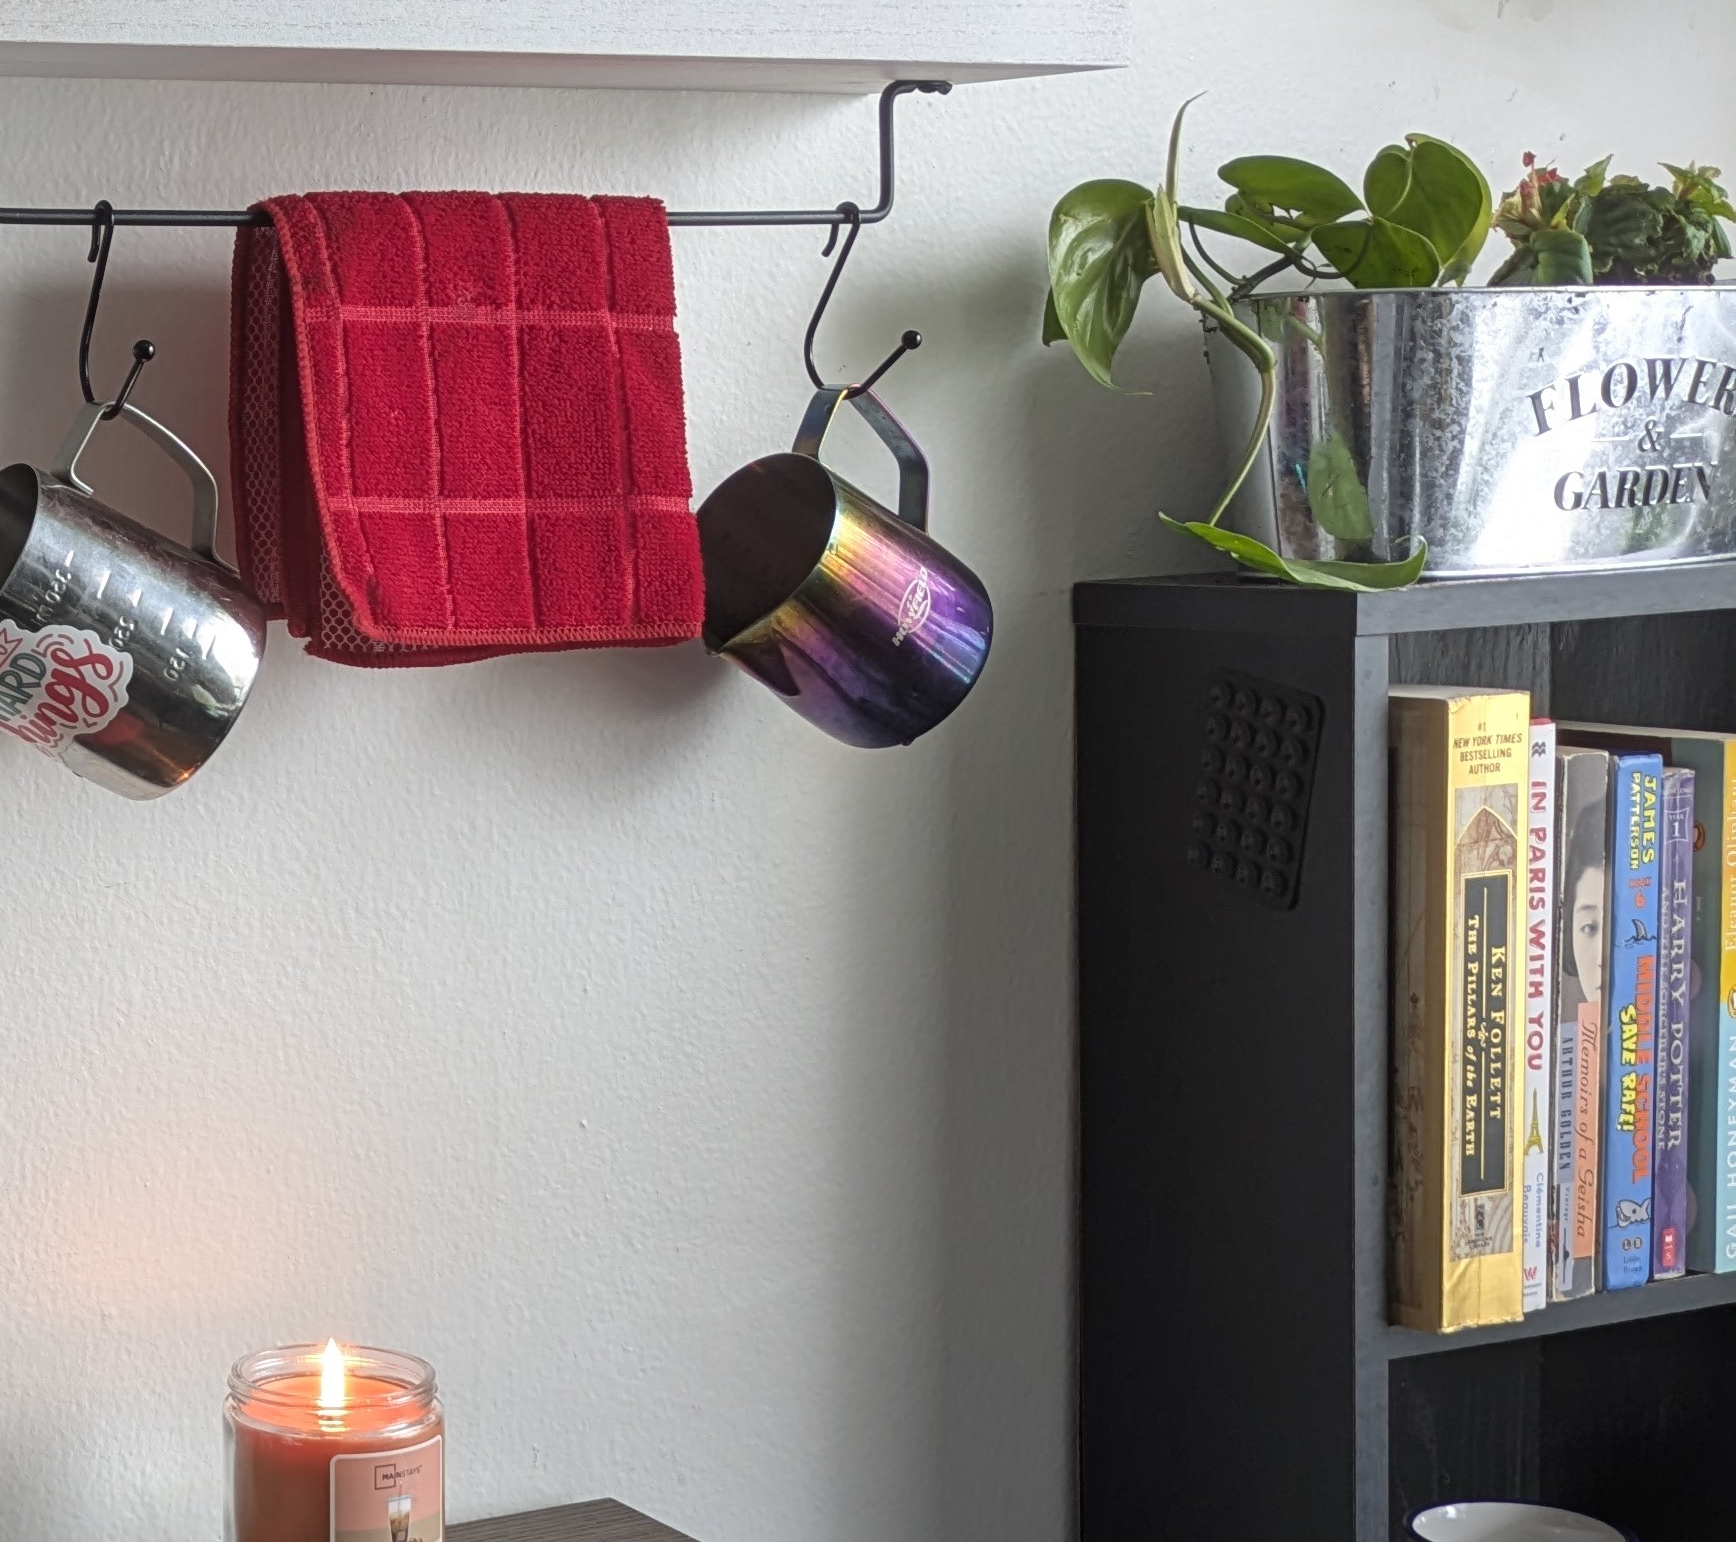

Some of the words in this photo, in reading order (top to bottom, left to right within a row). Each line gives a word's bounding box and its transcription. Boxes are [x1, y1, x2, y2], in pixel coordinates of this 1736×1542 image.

[1638, 415, 1664, 453] &
[1554, 462, 1718, 511] GARDEN
[1453, 738, 1470, 748] NEW
[1472, 735, 1493, 746] YORK
[1495, 733, 1523, 744] TIMES
[1460, 748, 1512, 762] BESTSELLING
[1469, 763, 1501, 775] AUTHOR
[1530, 781, 1547, 813] IN
[1630, 772, 1641, 870] PATTERSON
[1642, 775, 1657, 865] JAMES
[1528, 827, 1547, 910] PARIS
[1467, 915, 1480, 955] THE
[1527, 919, 1546, 999] WITH
[1670, 879, 1688, 1006] HARRY
[1466, 962, 1479, 1039] PILLARS
[1491, 946, 1506, 997] KEN
[1619, 1004, 1638, 1066] SAVE
[1635, 955, 1655, 1065] MIDDLE
[1465, 1045, 1477, 1061] of
[1489, 1010, 1505, 1119] FOLLETT
[1527, 1011, 1545, 1071] YOU
[1561, 1037, 1574, 1100] ARTHUR
[1580, 1021, 1598, 1115] Memoirs
[1466, 1065, 1477, 1087] the
[1616, 1072, 1638, 1132] RAFE!
[1668, 1022, 1684, 1150] POTTER
[1465, 1094, 1478, 1156] EARTH
[1559, 1109, 1572, 1170] GOLDEN
[1575, 1122, 1595, 1145] of
[1578, 1148, 1587, 1160] a
[1632, 1072, 1652, 1184] SCHOOL
[1576, 1166, 1595, 1238] Geisha
